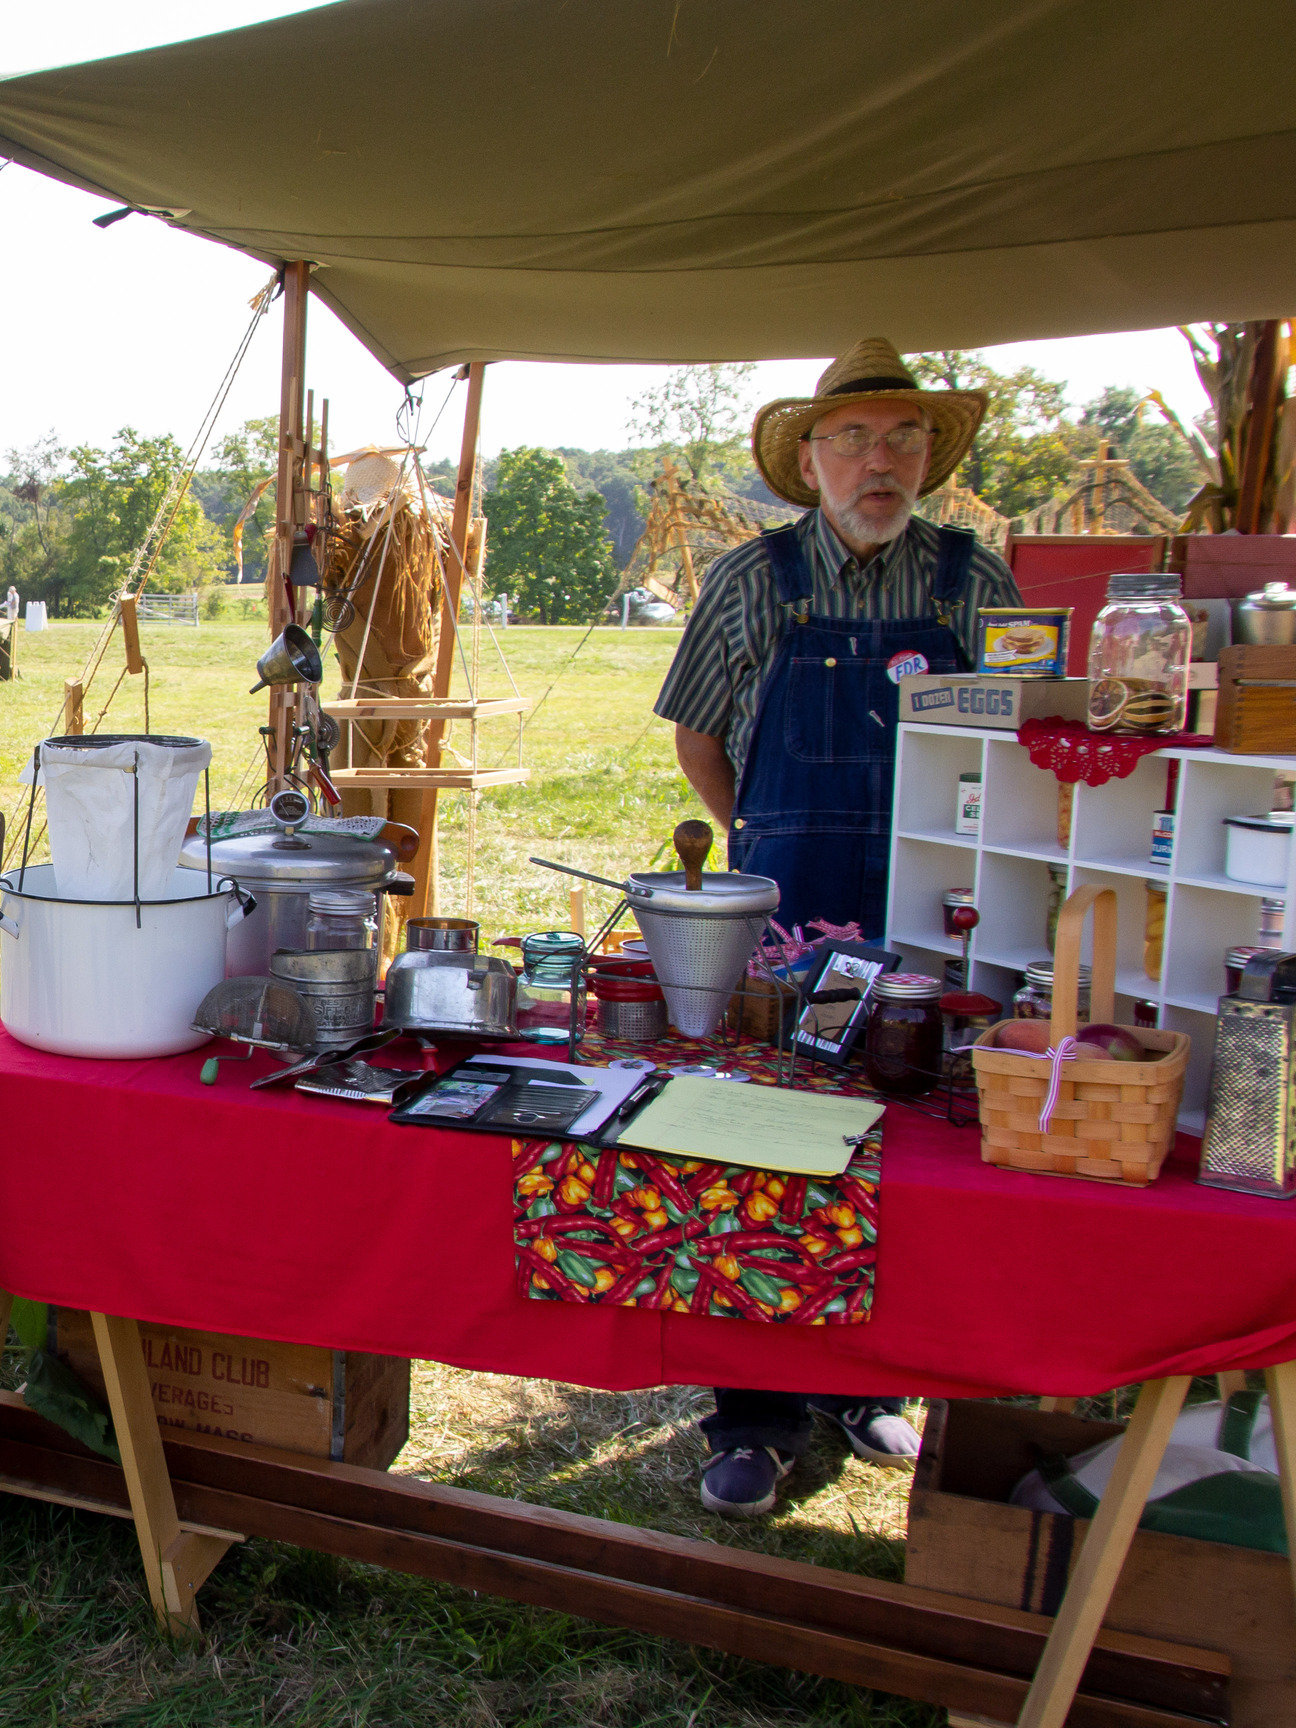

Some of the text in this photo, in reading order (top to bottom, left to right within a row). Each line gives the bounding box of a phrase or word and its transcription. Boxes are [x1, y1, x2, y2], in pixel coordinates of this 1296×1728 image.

[895, 657, 924, 682] FDR
[922, 691, 951, 707] DOZEN
[958, 687, 1013, 716] EGGS
[212, 1352, 270, 1388] CLUB
